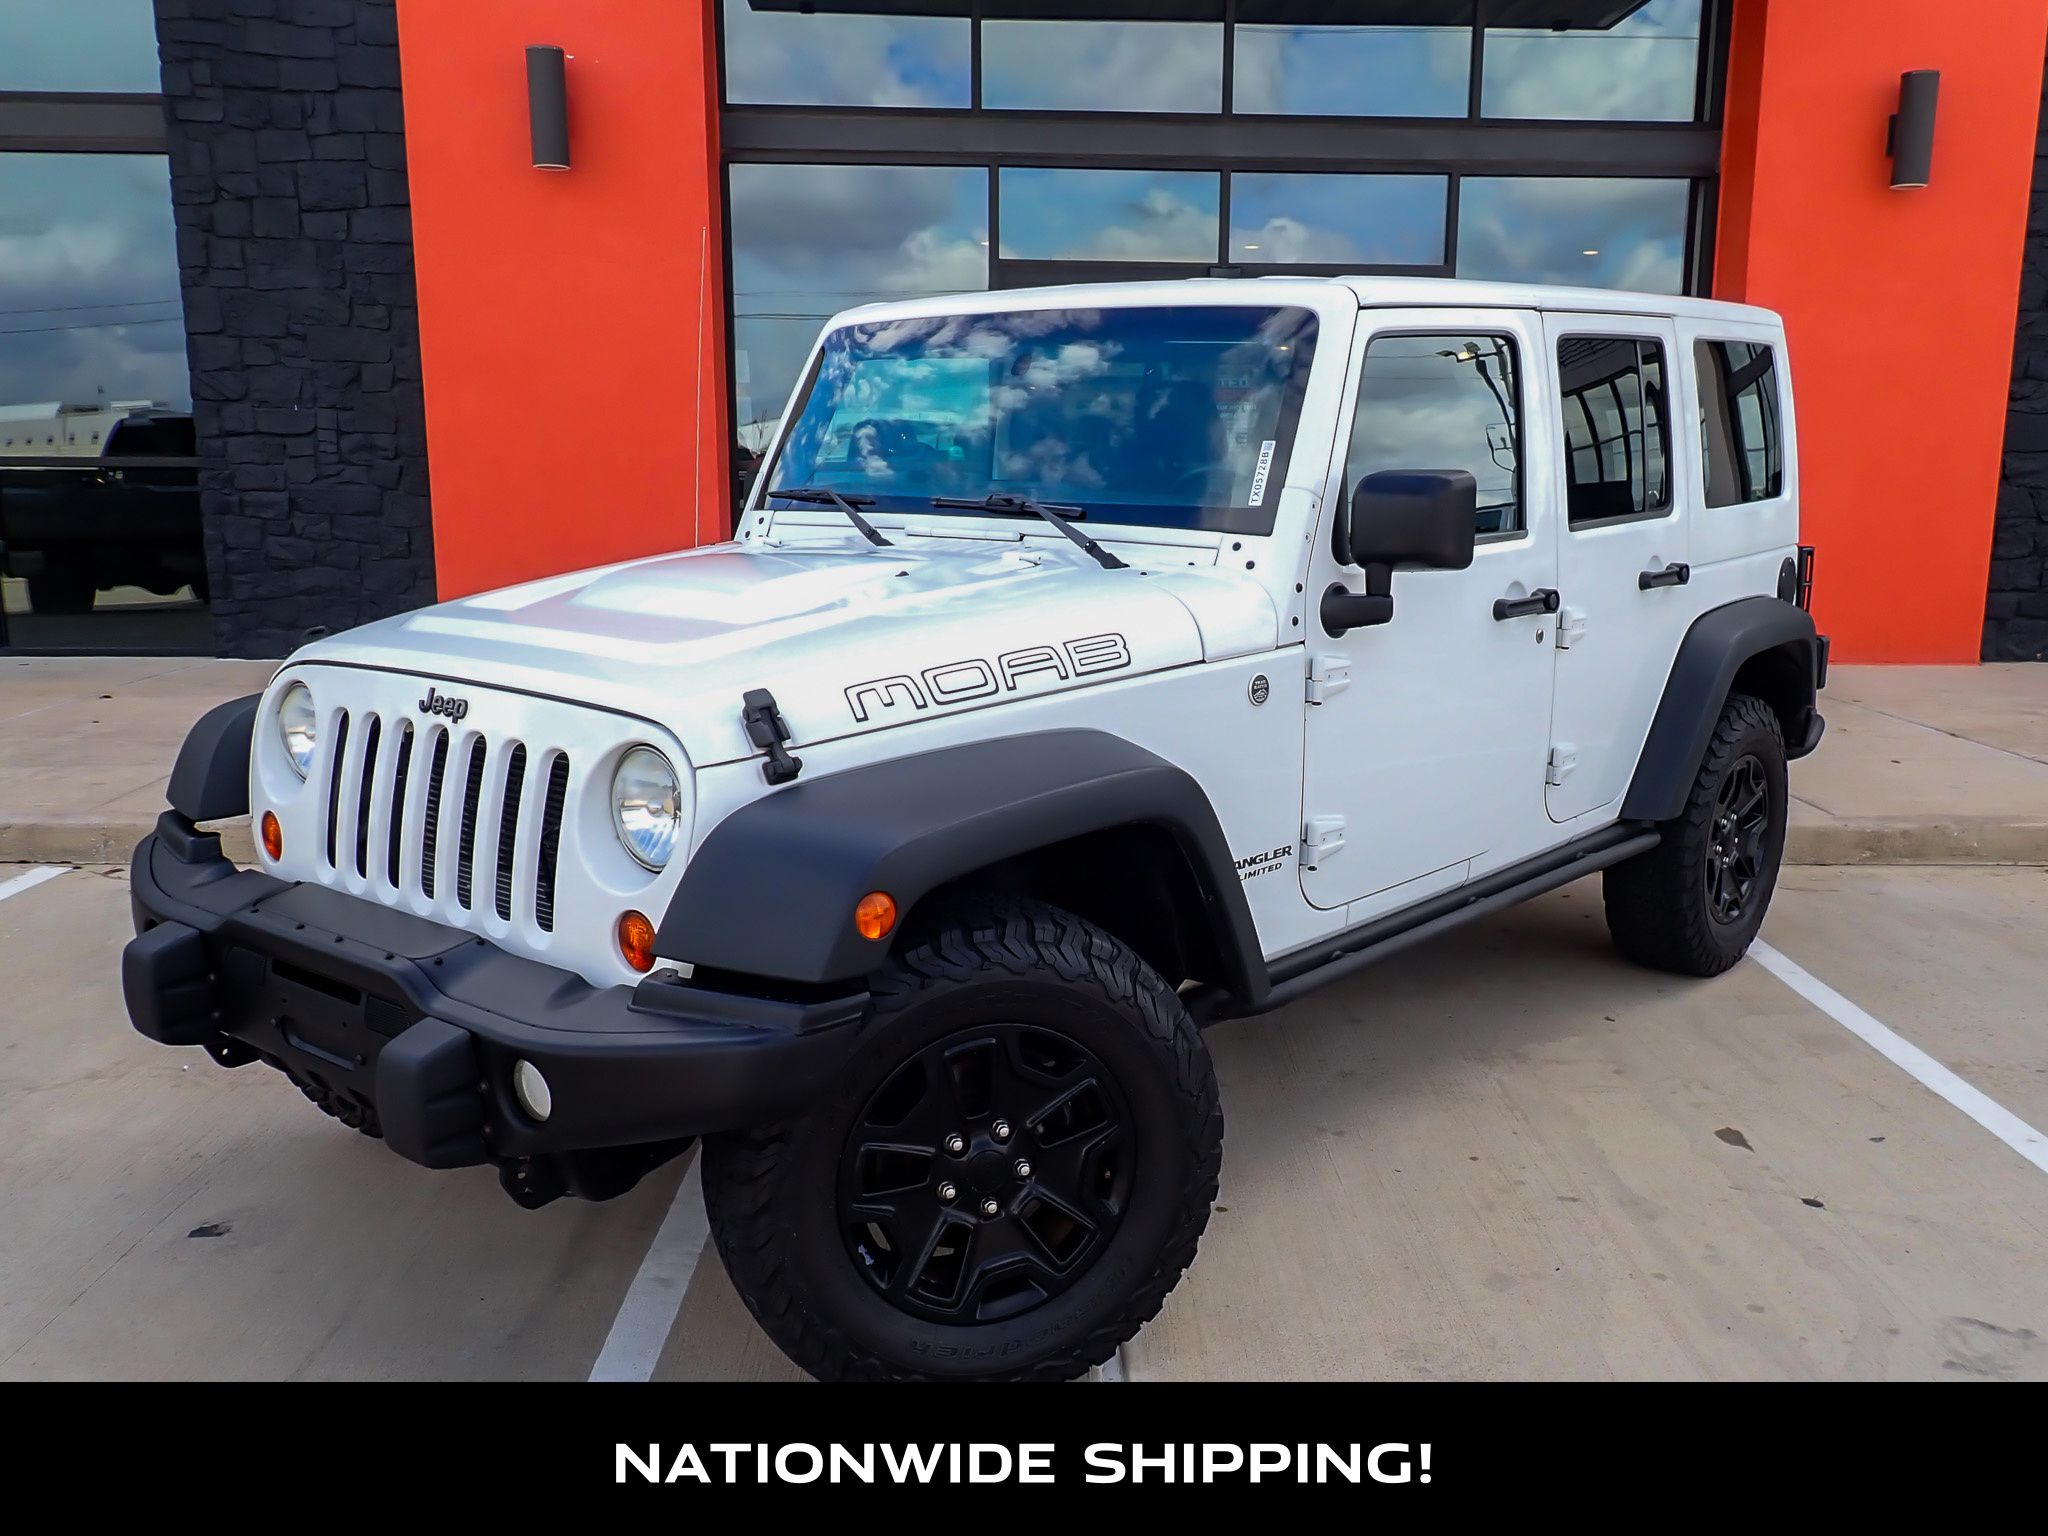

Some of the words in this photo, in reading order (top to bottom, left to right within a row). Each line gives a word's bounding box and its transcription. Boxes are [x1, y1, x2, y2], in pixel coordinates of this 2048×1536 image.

[1250, 451, 1269, 504] TX05728B
[844, 633, 1132, 723] MOAB
[418, 687, 469, 725] Jeep
[1234, 845, 1293, 870] ANGLER
[1238, 862, 1282, 881] LIMITED
